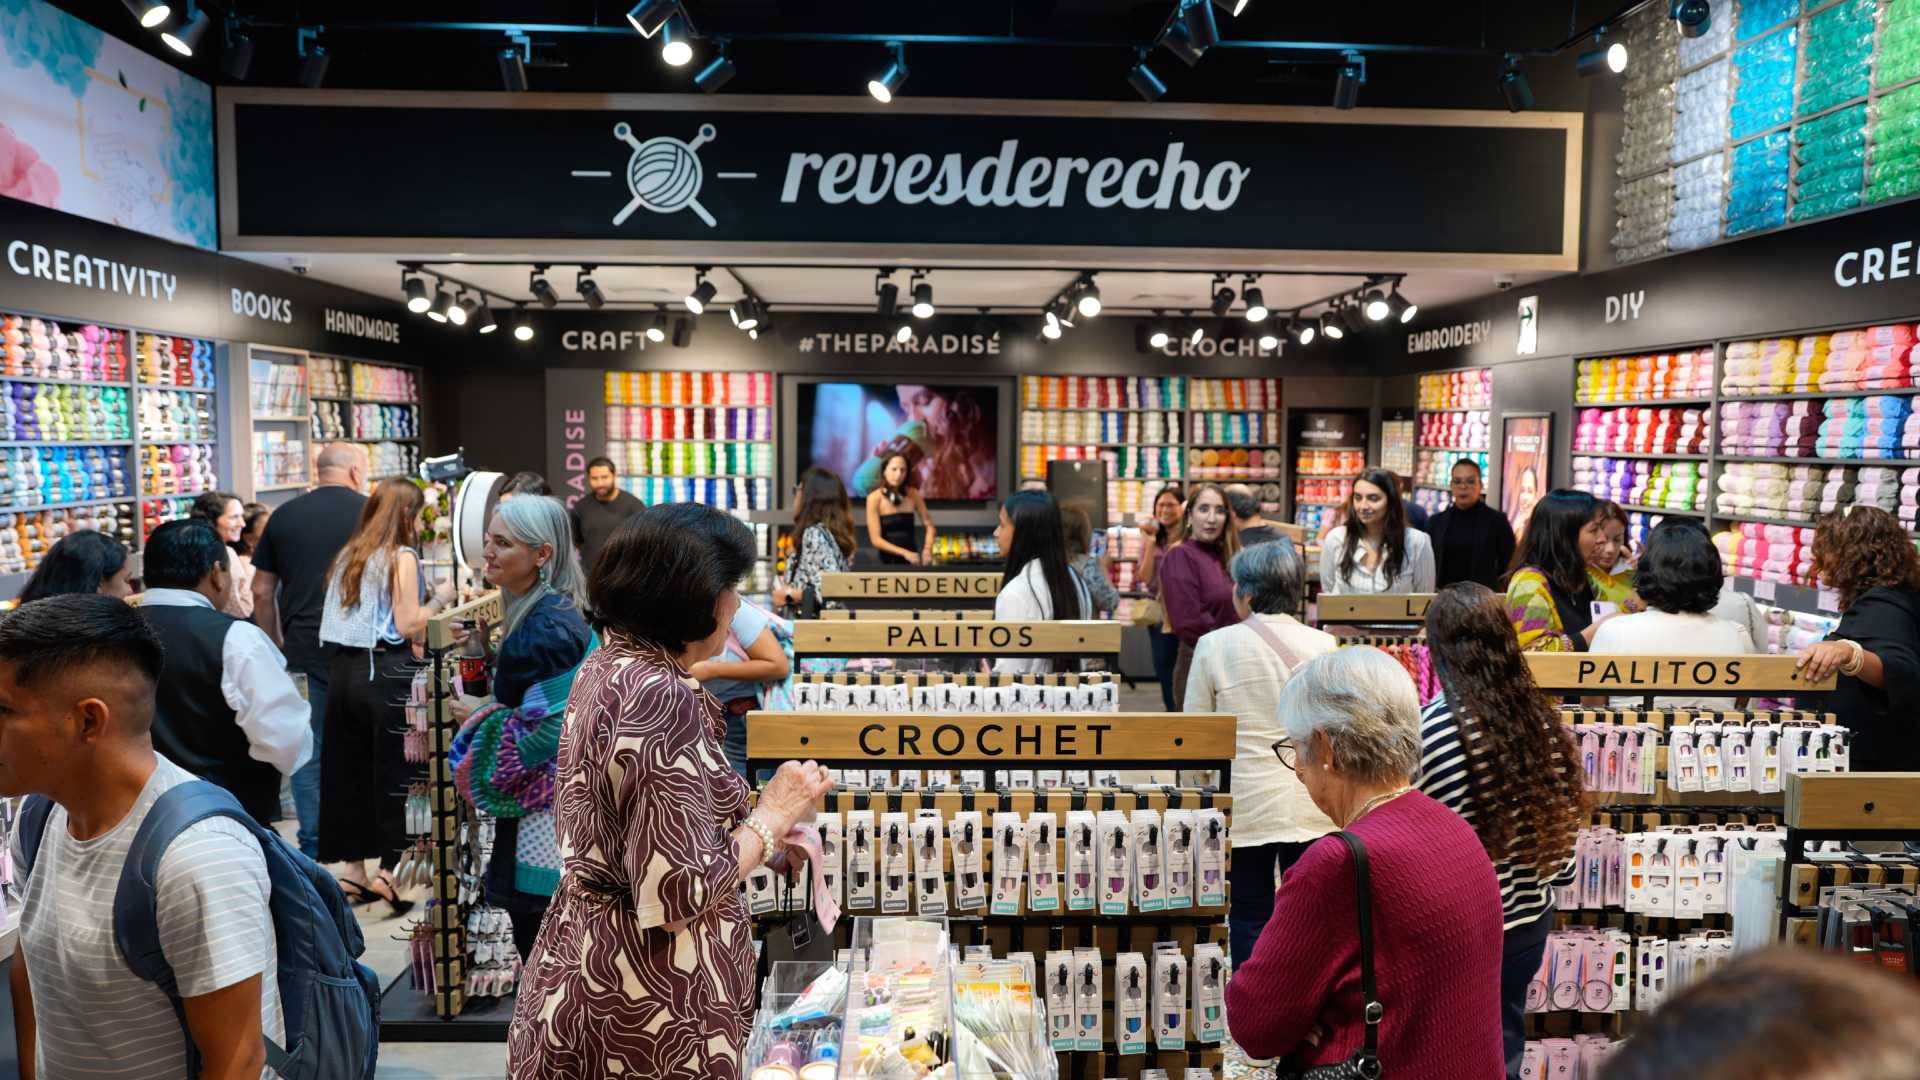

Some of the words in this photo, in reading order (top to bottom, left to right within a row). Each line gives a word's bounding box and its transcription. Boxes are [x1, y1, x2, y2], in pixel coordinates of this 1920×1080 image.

[781, 139, 1250, 210] revesderecho
[8, 240, 177, 301] CREATIVITY
[231, 288, 292, 323] BOOKS
[1605, 291, 1644, 323] DIY
[325, 308, 400, 344] HANDMADE
[562, 330, 649, 350] CRAFT
[1408, 320, 1490, 353] EMBROIDERY
[799, 332, 1001, 354] #THEPARADISE
[860, 577, 998, 594] TENDENCI
[887, 626, 1032, 647] PALITOS
[1578, 660, 1741, 685] PALITOS
[858, 723, 1112, 756] CROCHET
